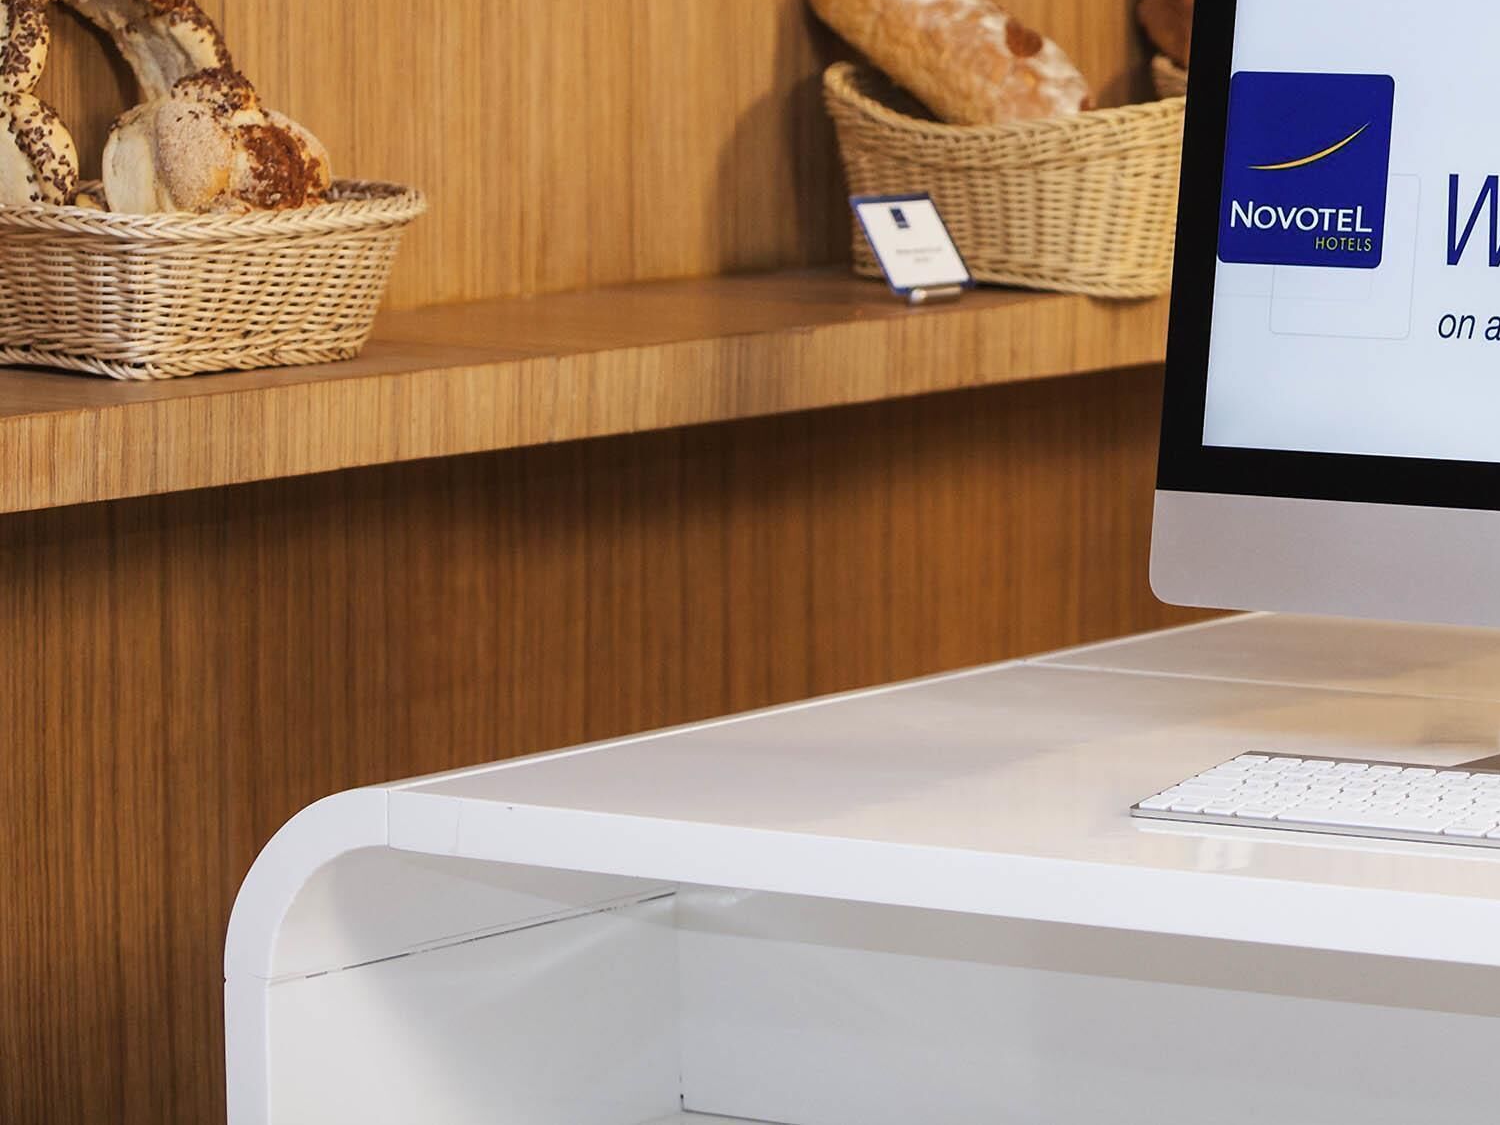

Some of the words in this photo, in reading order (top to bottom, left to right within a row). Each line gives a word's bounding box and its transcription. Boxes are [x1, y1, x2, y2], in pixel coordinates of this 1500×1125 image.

[1230, 200, 1373, 233] NOVOTEL
[1315, 236, 1373, 252] HOTELS
[1437, 313, 1476, 340] on
